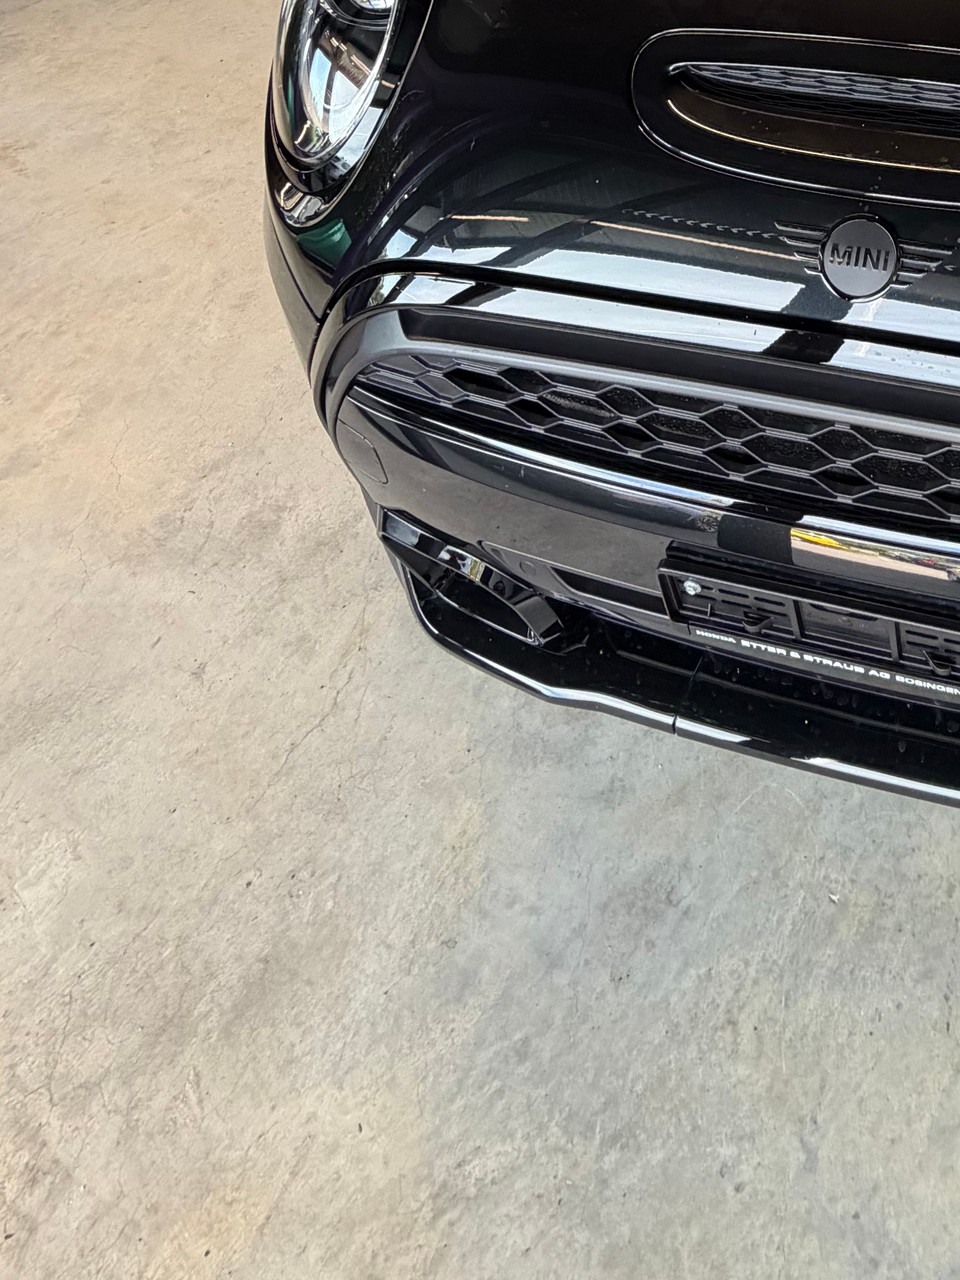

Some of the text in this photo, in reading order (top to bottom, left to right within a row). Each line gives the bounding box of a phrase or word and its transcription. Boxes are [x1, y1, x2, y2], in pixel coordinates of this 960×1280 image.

[829, 242, 890, 272] MINI
[696, 629, 737, 644] HONDA
[740, 639, 787, 657] ETTER
[790, 651, 801, 659] &
[868, 669, 891, 680] AG
